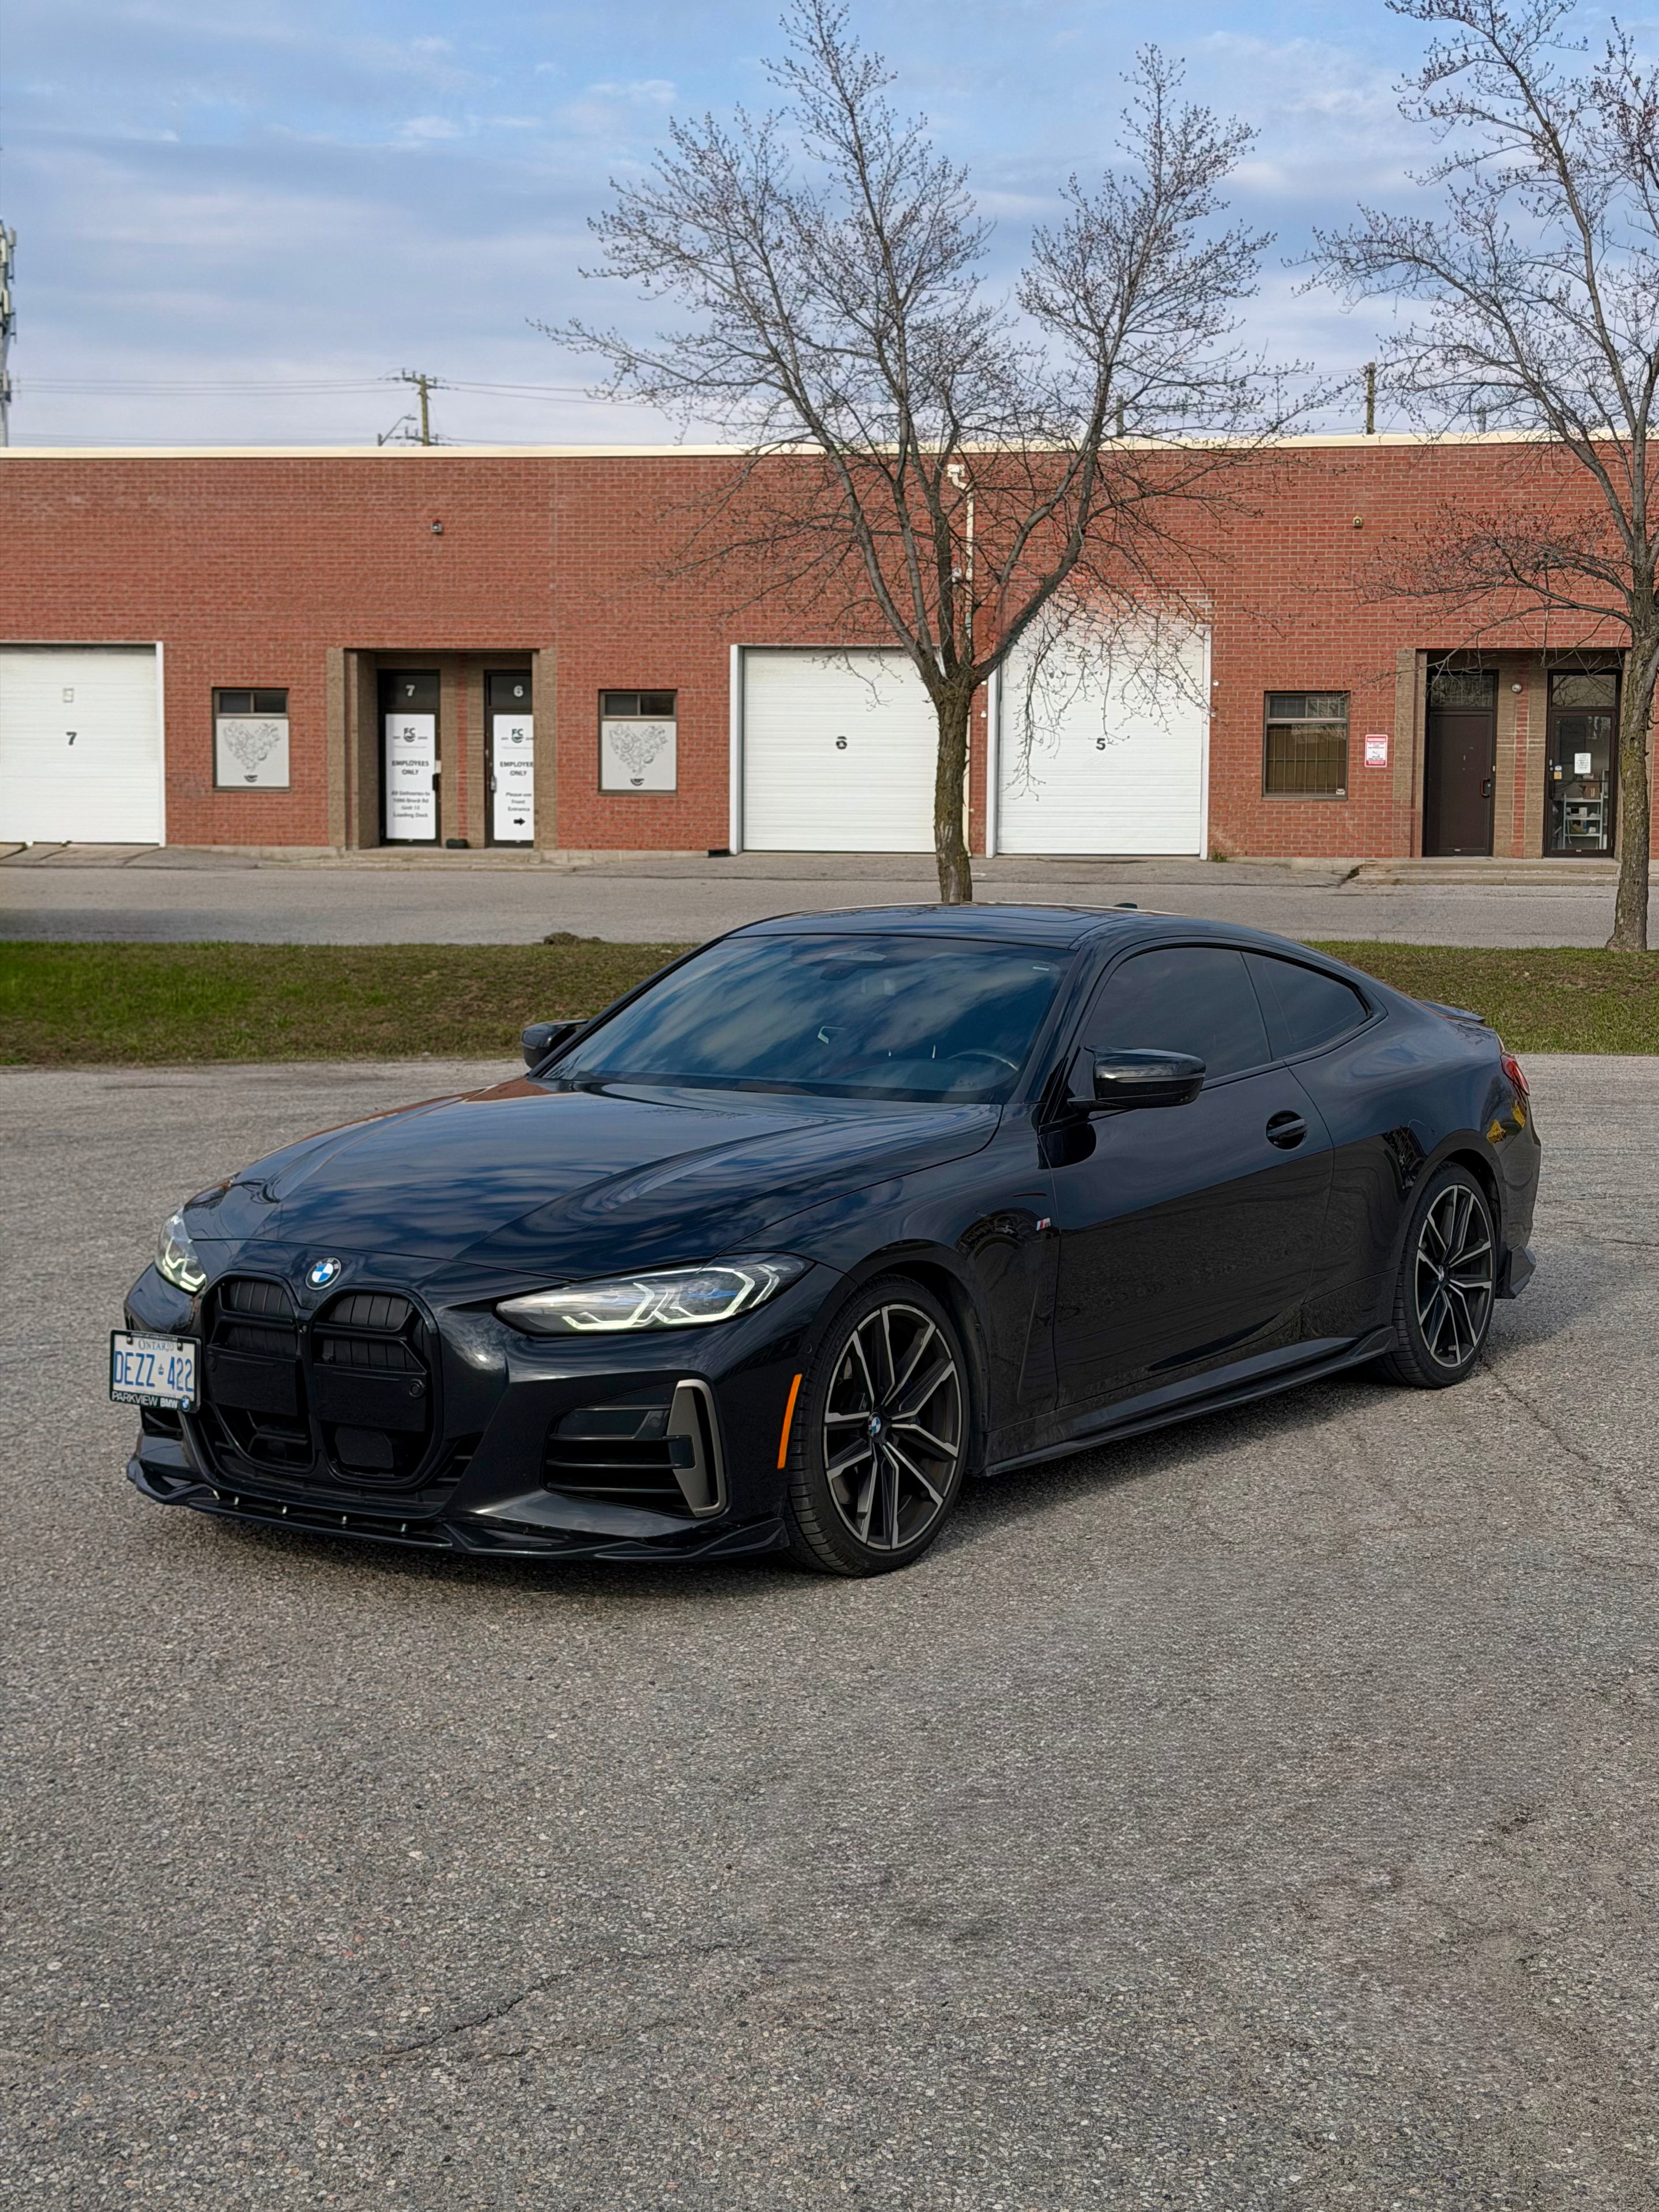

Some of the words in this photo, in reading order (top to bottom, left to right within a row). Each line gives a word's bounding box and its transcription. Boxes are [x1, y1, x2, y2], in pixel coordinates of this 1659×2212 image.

[405, 684, 415, 696] 7
[513, 685, 523, 697] 6
[66, 732, 77, 746] 7
[836, 736, 847, 750] 6
[1096, 738, 1105, 750] 5
[138, 1338, 174, 1352] ONTARIO
[114, 1350, 155, 1387] DEZZ
[167, 1356, 194, 1392] 422
[111, 1390, 158, 1406] PARKVIEW
[160, 1397, 178, 1409] BMW
